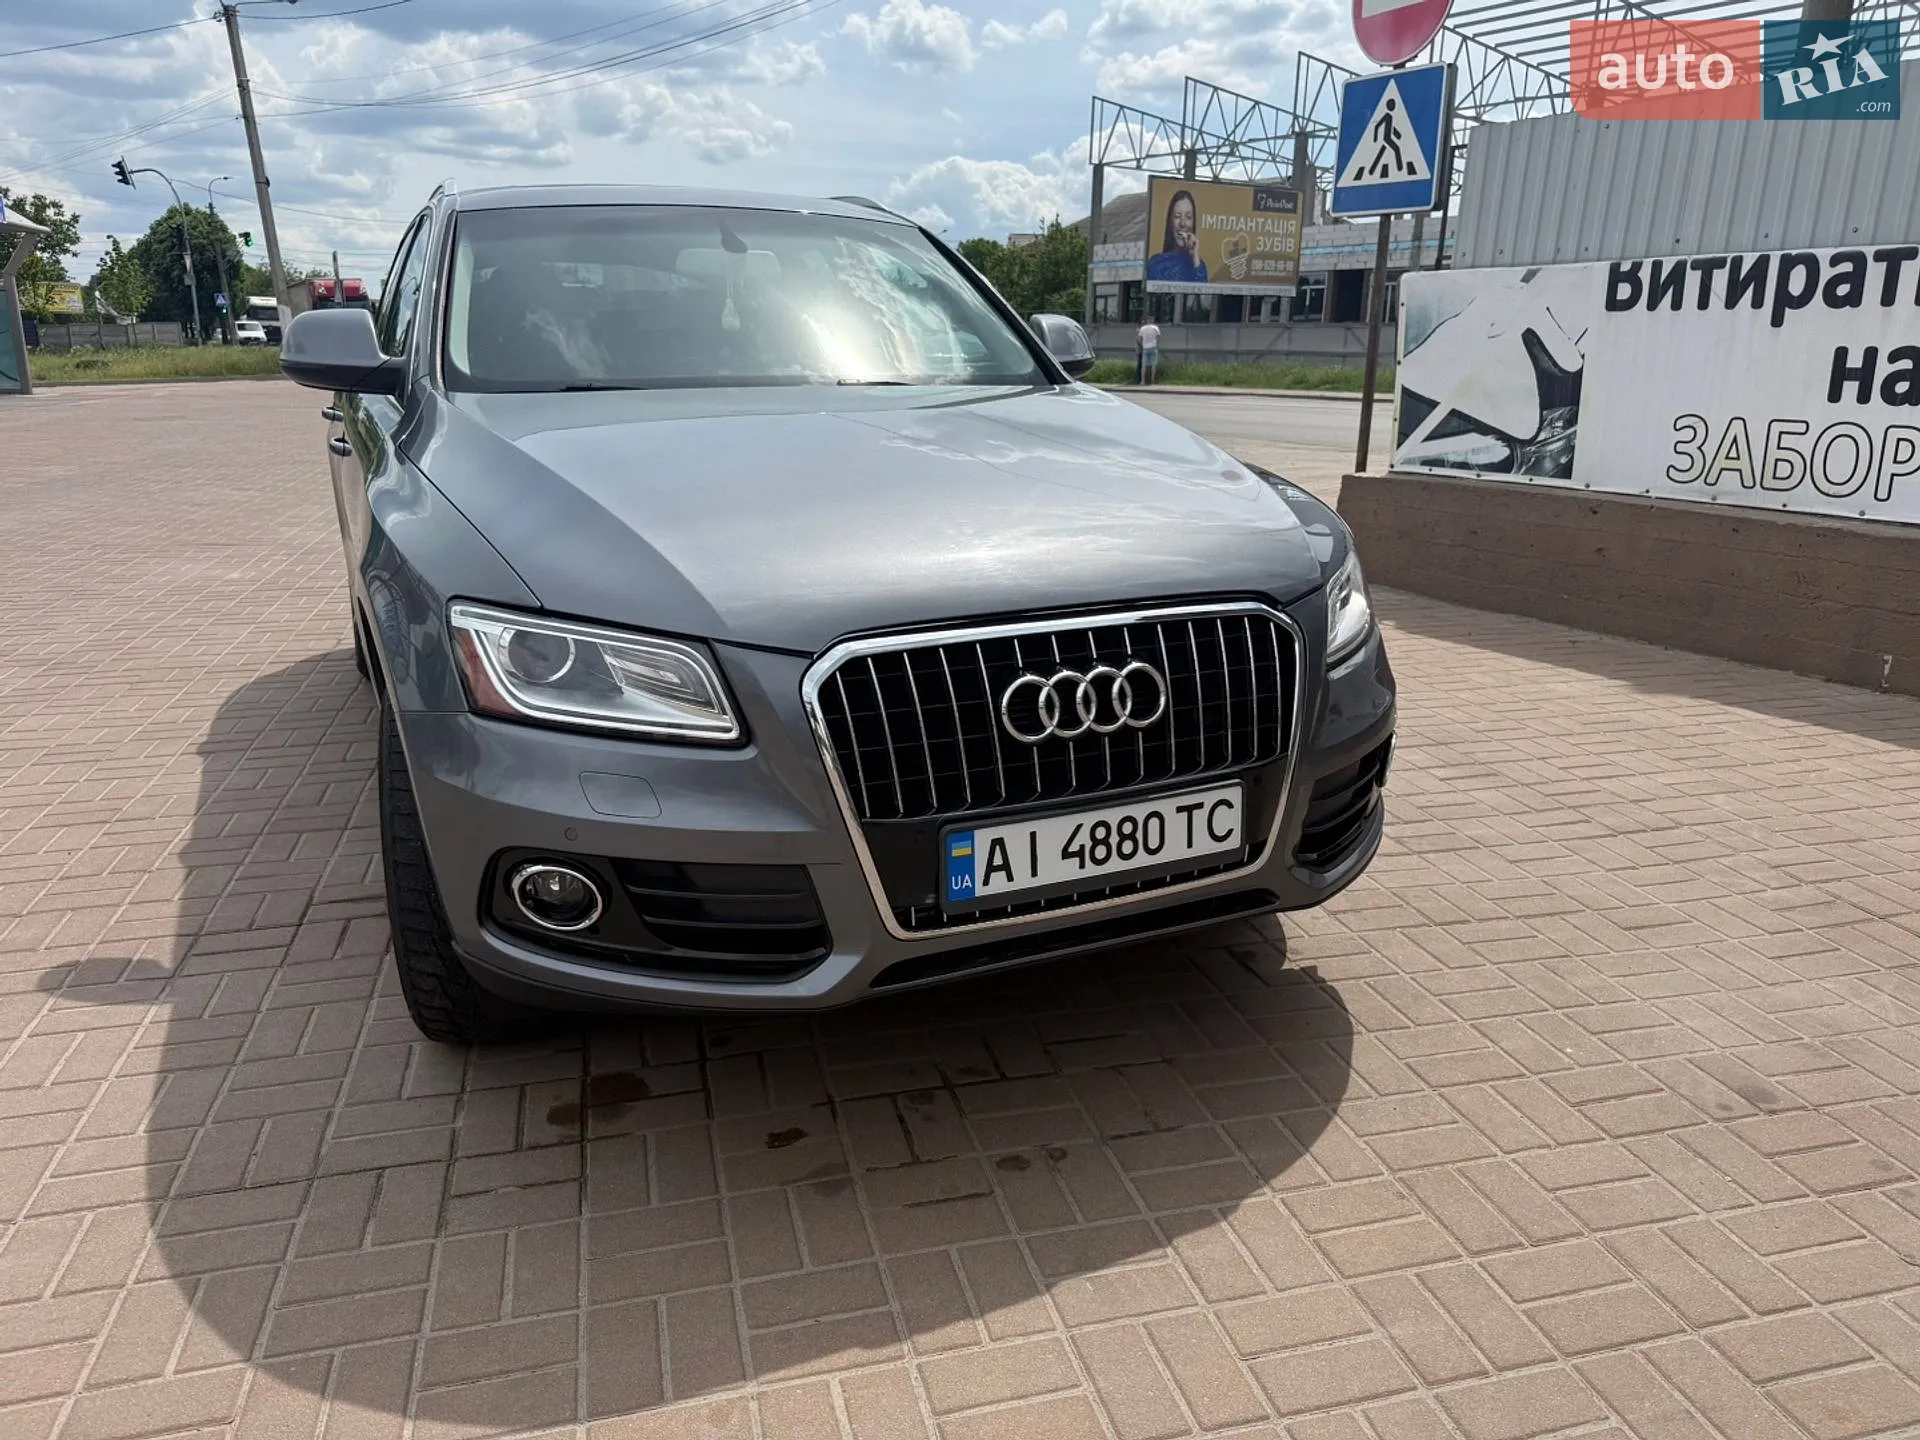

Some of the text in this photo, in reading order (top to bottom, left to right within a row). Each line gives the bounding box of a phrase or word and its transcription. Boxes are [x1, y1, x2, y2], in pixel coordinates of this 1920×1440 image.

[1201, 213, 1296, 234] ІМПЛАНТАЦІЯ
[1256, 236, 1295, 252] ЗУБІВ
[1605, 245, 1920, 328] Витират
[1827, 345, 1920, 406] на
[1666, 413, 1920, 502] ЗАБОР
[982, 798, 1235, 887] AI 4880 TC
[951, 873, 973, 890] UA
